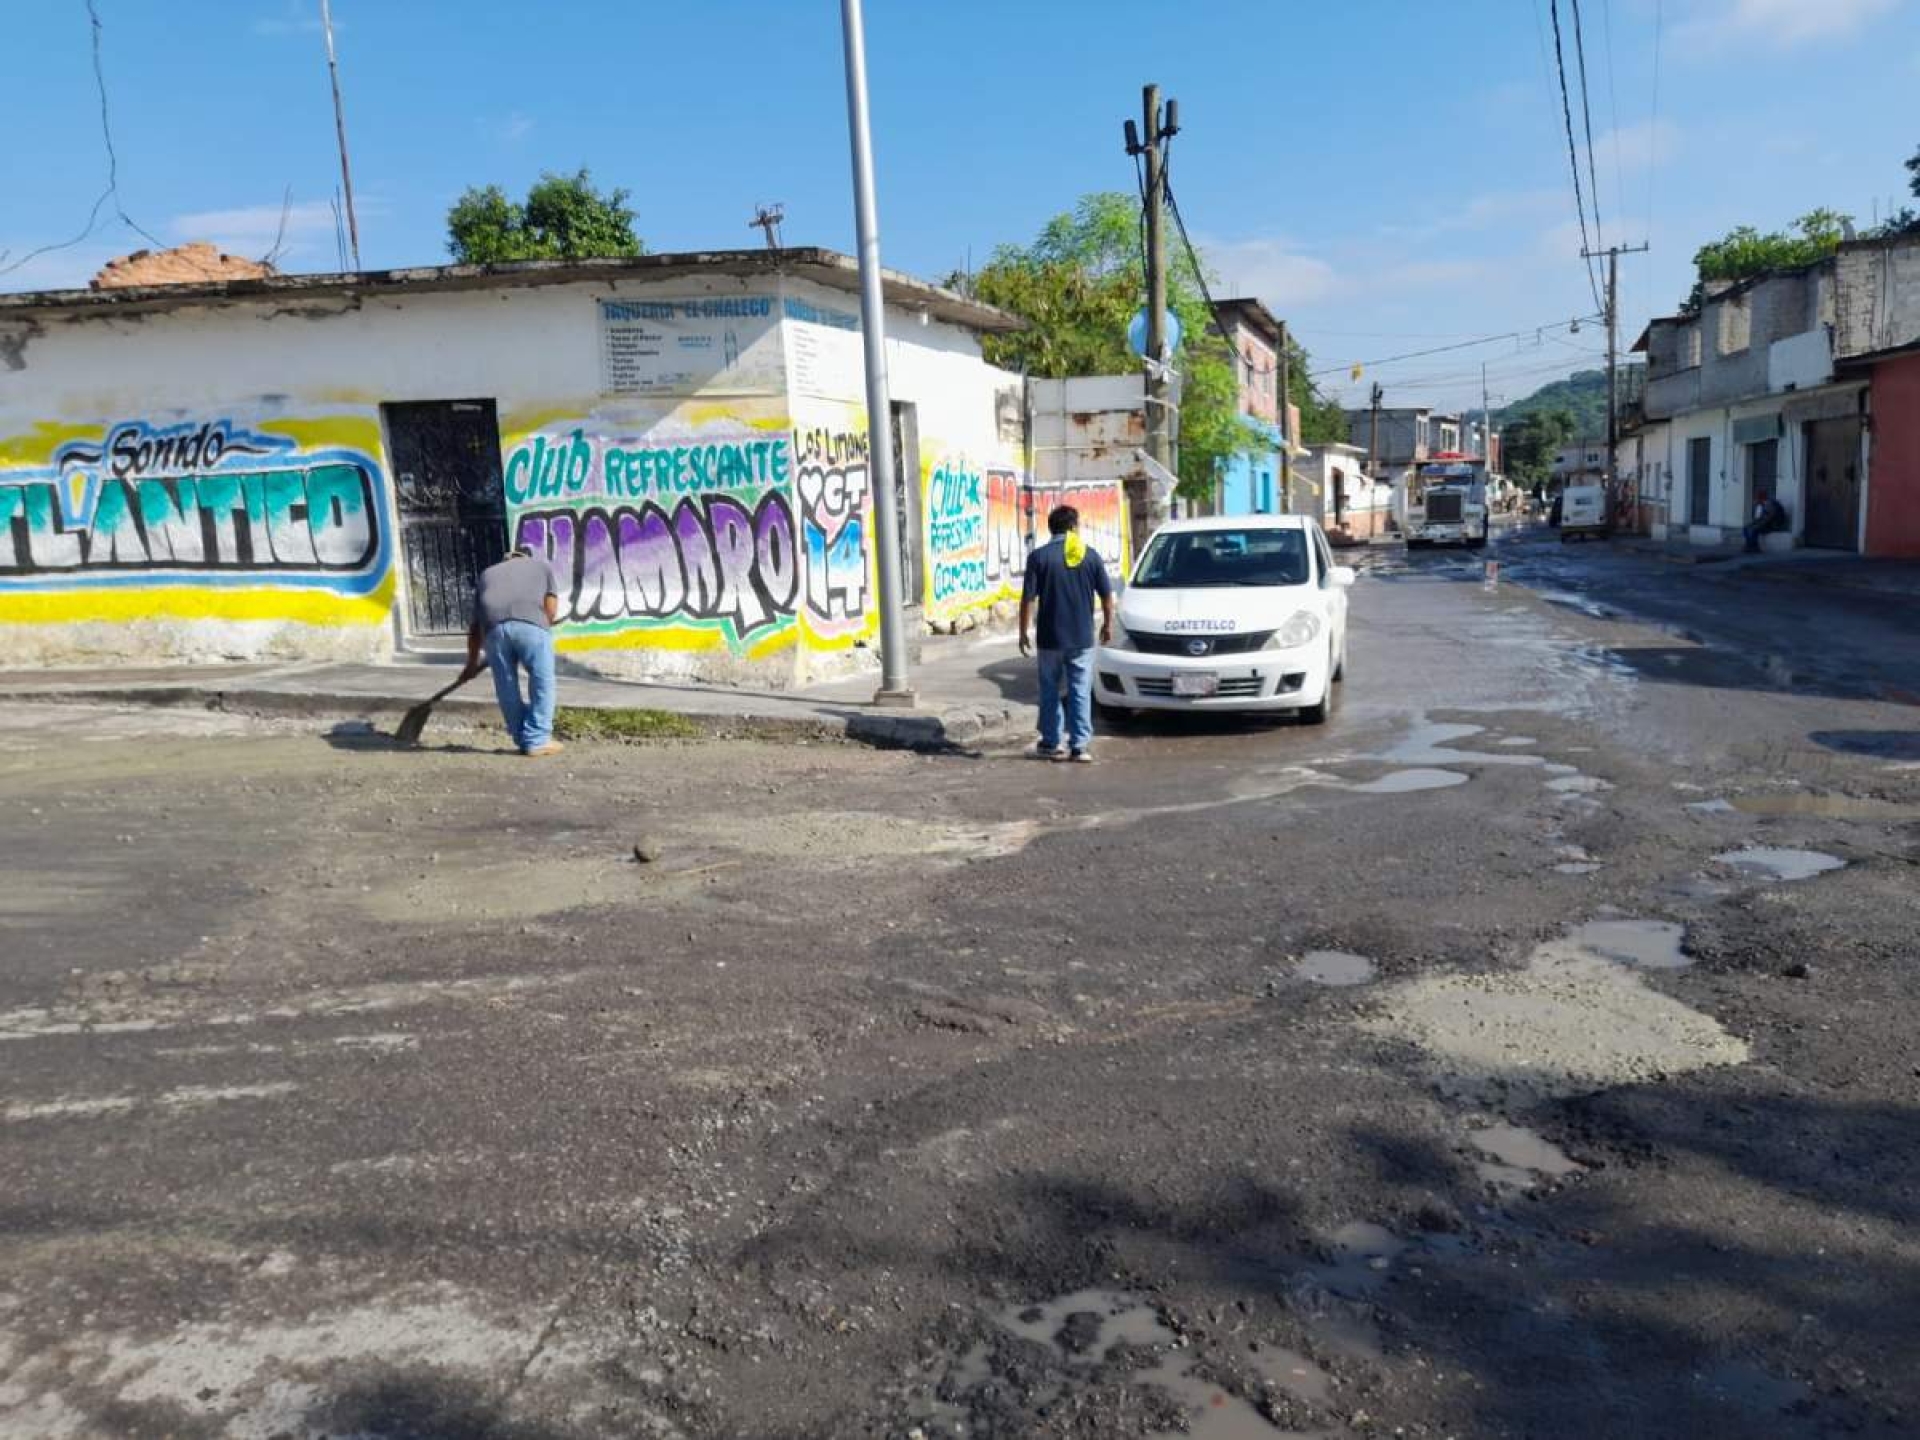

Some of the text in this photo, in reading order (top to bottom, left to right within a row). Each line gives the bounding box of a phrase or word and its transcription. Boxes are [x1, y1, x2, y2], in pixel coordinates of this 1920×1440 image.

[111, 422, 225, 477] Sonido
[604, 439, 789, 498] REFRESCANTE
[0, 462, 378, 575] TLANTICO
[1164, 619, 1236, 632] COATETELCO
